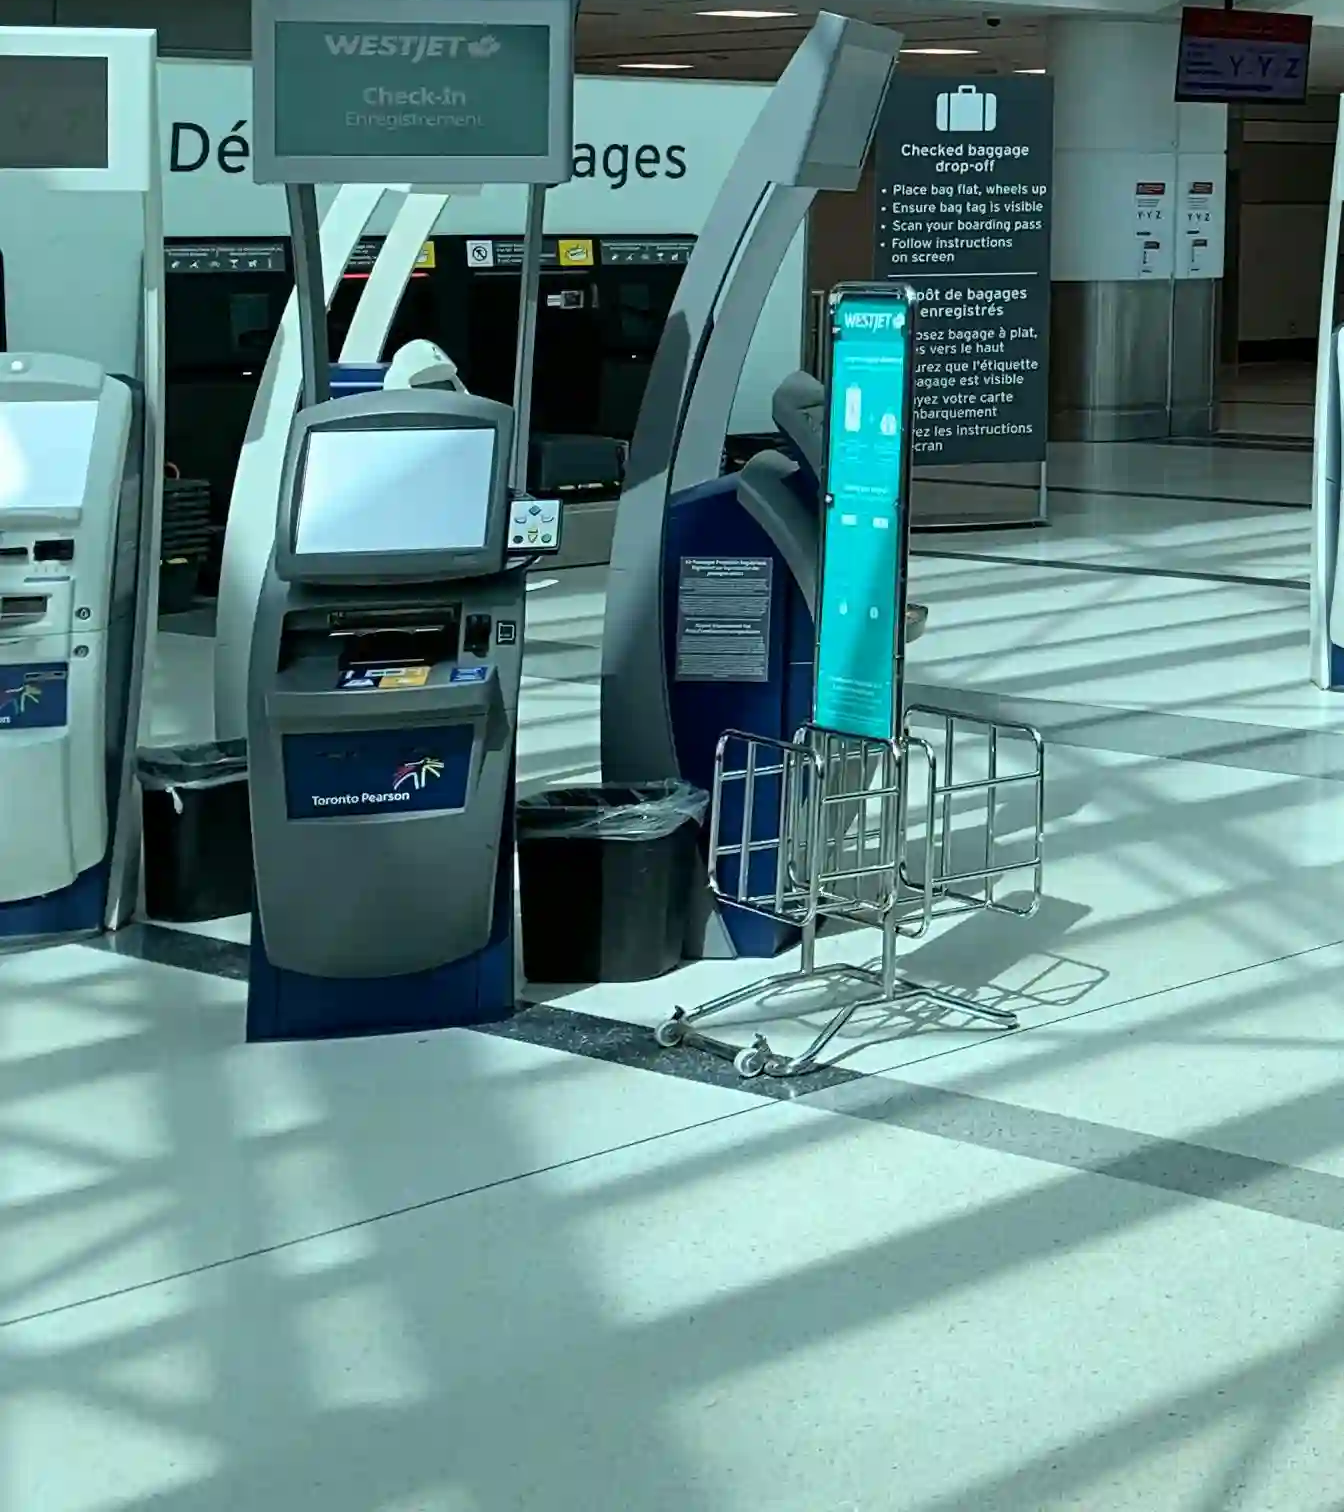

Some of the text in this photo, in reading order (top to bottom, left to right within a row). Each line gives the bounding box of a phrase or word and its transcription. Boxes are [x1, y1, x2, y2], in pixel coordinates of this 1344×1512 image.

[324, 34, 462, 64] WESTJET
[345, 111, 484, 129] Enregistrement
[901, 143, 1030, 159] Checked baggage
[935, 159, 995, 175] drop-off
[893, 183, 1047, 198] Place bag flat, wheels up
[892, 201, 1044, 216] Ensure bag tag is visible
[892, 219, 1042, 234] Scan your boarding pass
[892, 237, 1013, 249] Follow instructions
[892, 252, 955, 264] on screen
[944, 288, 962, 301] de
[967, 287, 1028, 303] bagages
[920, 304, 1004, 320] enregistrés
[845, 311, 892, 333] WESTJET
[948, 328, 995, 342] bagage
[999, 327, 1006, 339] à
[1010, 326, 1038, 341] plat,
[930, 341, 1005, 355] vers le haut
[945, 361, 969, 374] que
[972, 359, 1039, 373] l'étiquette
[915, 374, 1025, 389] agage est visible
[942, 393, 977, 405] votre
[980, 392, 1014, 403] carte
[934, 422, 1033, 437] les instructions
[312, 792, 410, 806] Toronto Pearson
